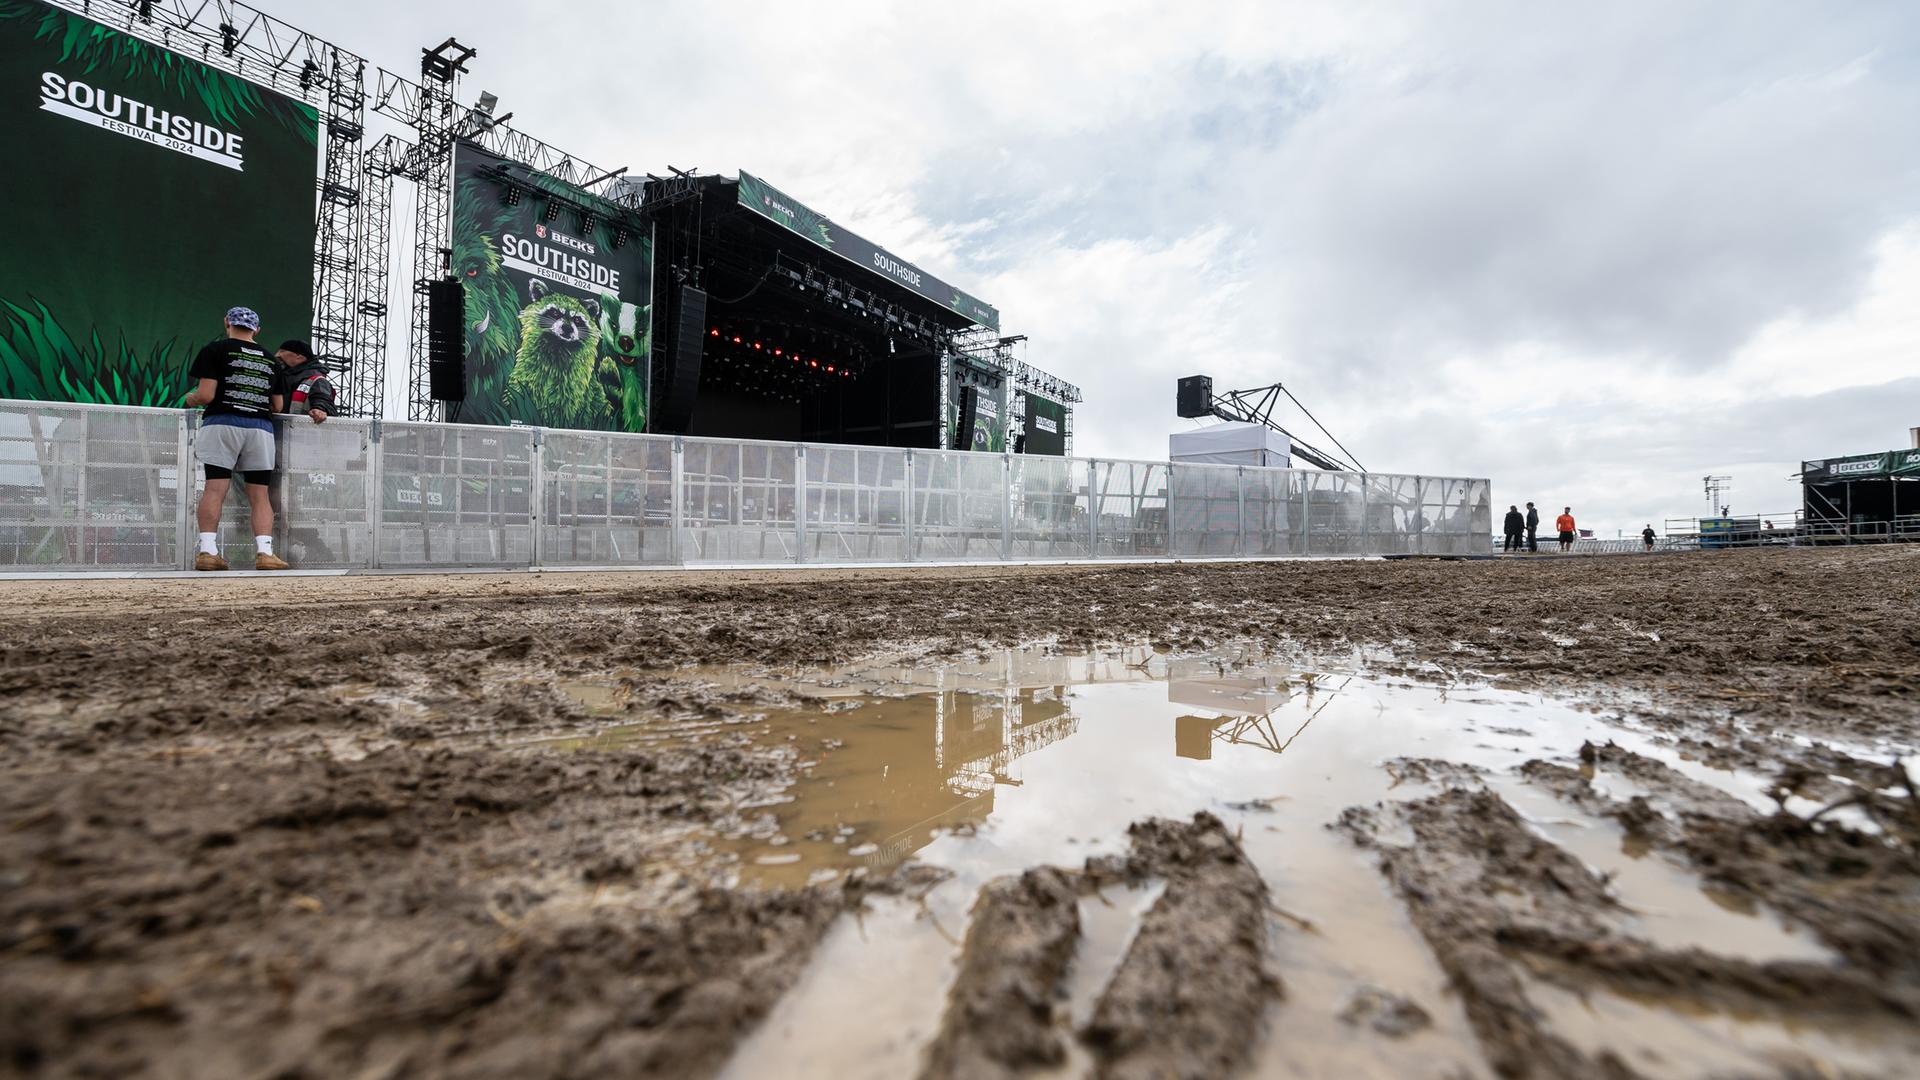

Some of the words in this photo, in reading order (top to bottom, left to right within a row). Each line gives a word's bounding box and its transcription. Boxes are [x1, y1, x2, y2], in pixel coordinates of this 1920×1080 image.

[41, 71, 243, 159] SOUTHSIDE
[102, 117, 158, 143] FESTIVAL
[165, 138, 194, 154] 2024
[551, 231, 595, 254] BECK'S
[502, 233, 620, 290] SOUTHSIDE
[874, 252, 921, 287] SOUTHSIDE
[537, 267, 570, 284] FESTIVAL
[573, 278, 592, 291] 2024
[976, 395, 997, 413] THSIDE
[1841, 462, 1878, 472] BECK'S
